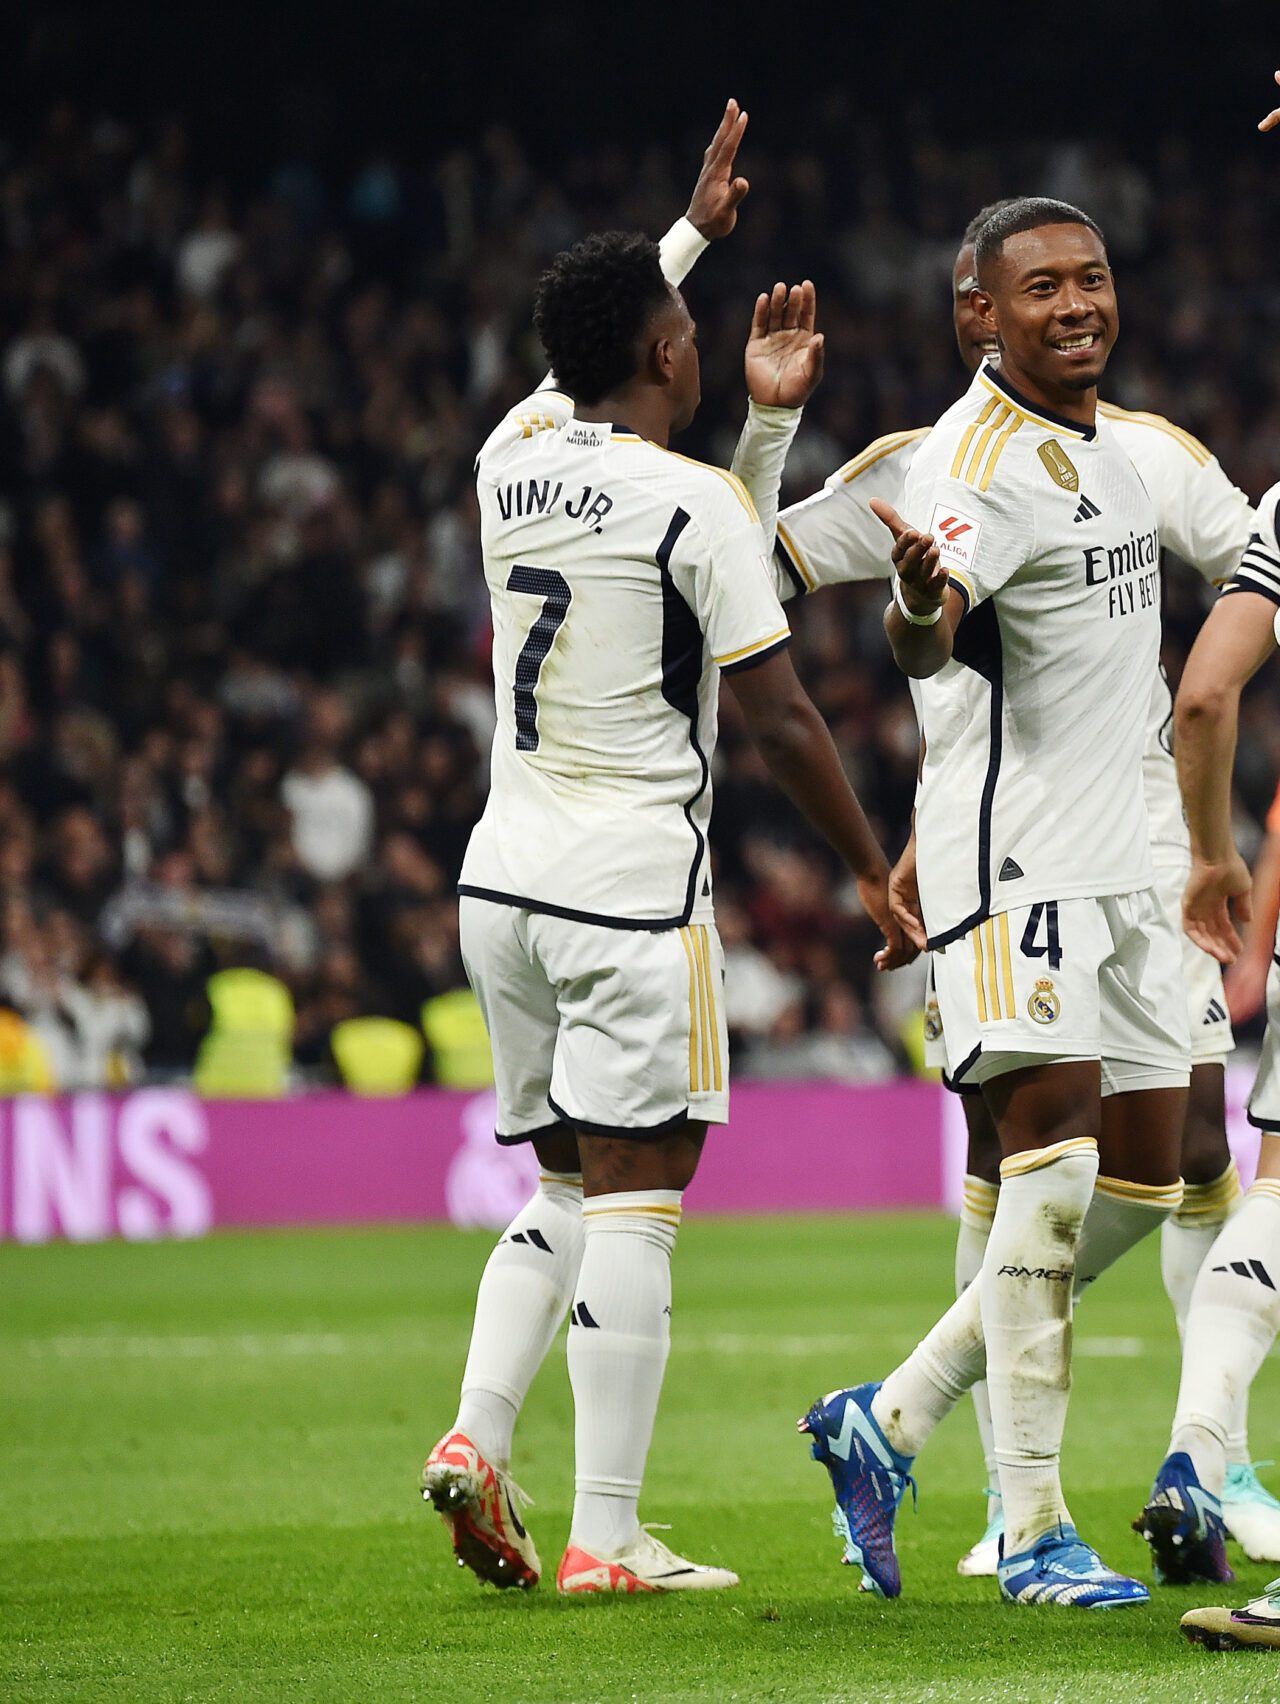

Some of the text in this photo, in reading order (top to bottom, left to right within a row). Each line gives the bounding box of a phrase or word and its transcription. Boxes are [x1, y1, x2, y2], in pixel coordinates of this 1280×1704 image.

[497, 479, 613, 535] VINI JR.
[1109, 581, 1134, 619] FLY
[505, 564, 573, 753] 7
[1020, 900, 1063, 971] 4
[12, 1087, 213, 1244] NS
